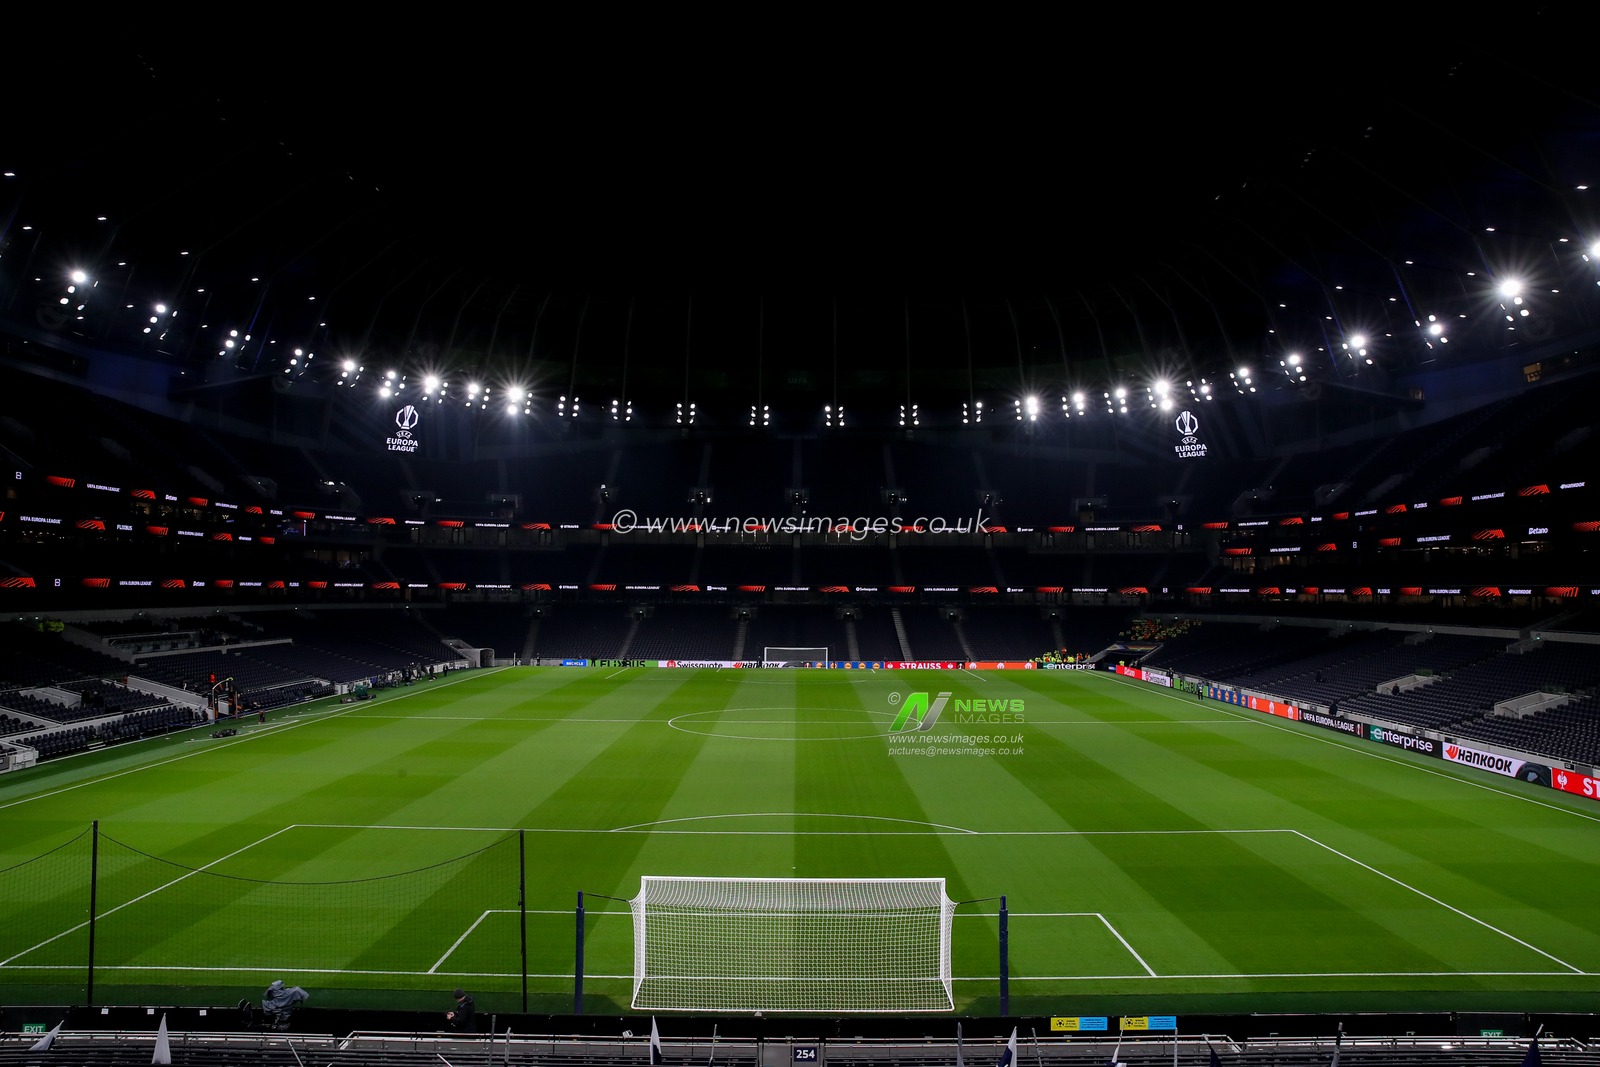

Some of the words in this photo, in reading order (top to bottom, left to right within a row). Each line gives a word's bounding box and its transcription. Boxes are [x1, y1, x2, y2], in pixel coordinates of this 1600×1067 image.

[386, 438, 418, 446] EUROPA
[1174, 444, 1207, 452] EUROPA
[1303, 712, 1316, 722] UEFA
[1316, 715, 1334, 727] EUROPA
[1334, 720, 1354, 732] LEAGUE
[1371, 727, 1433, 752] enterprise
[24, 1025, 44, 1034] EXIT
[796, 1050, 816, 1058] 254
